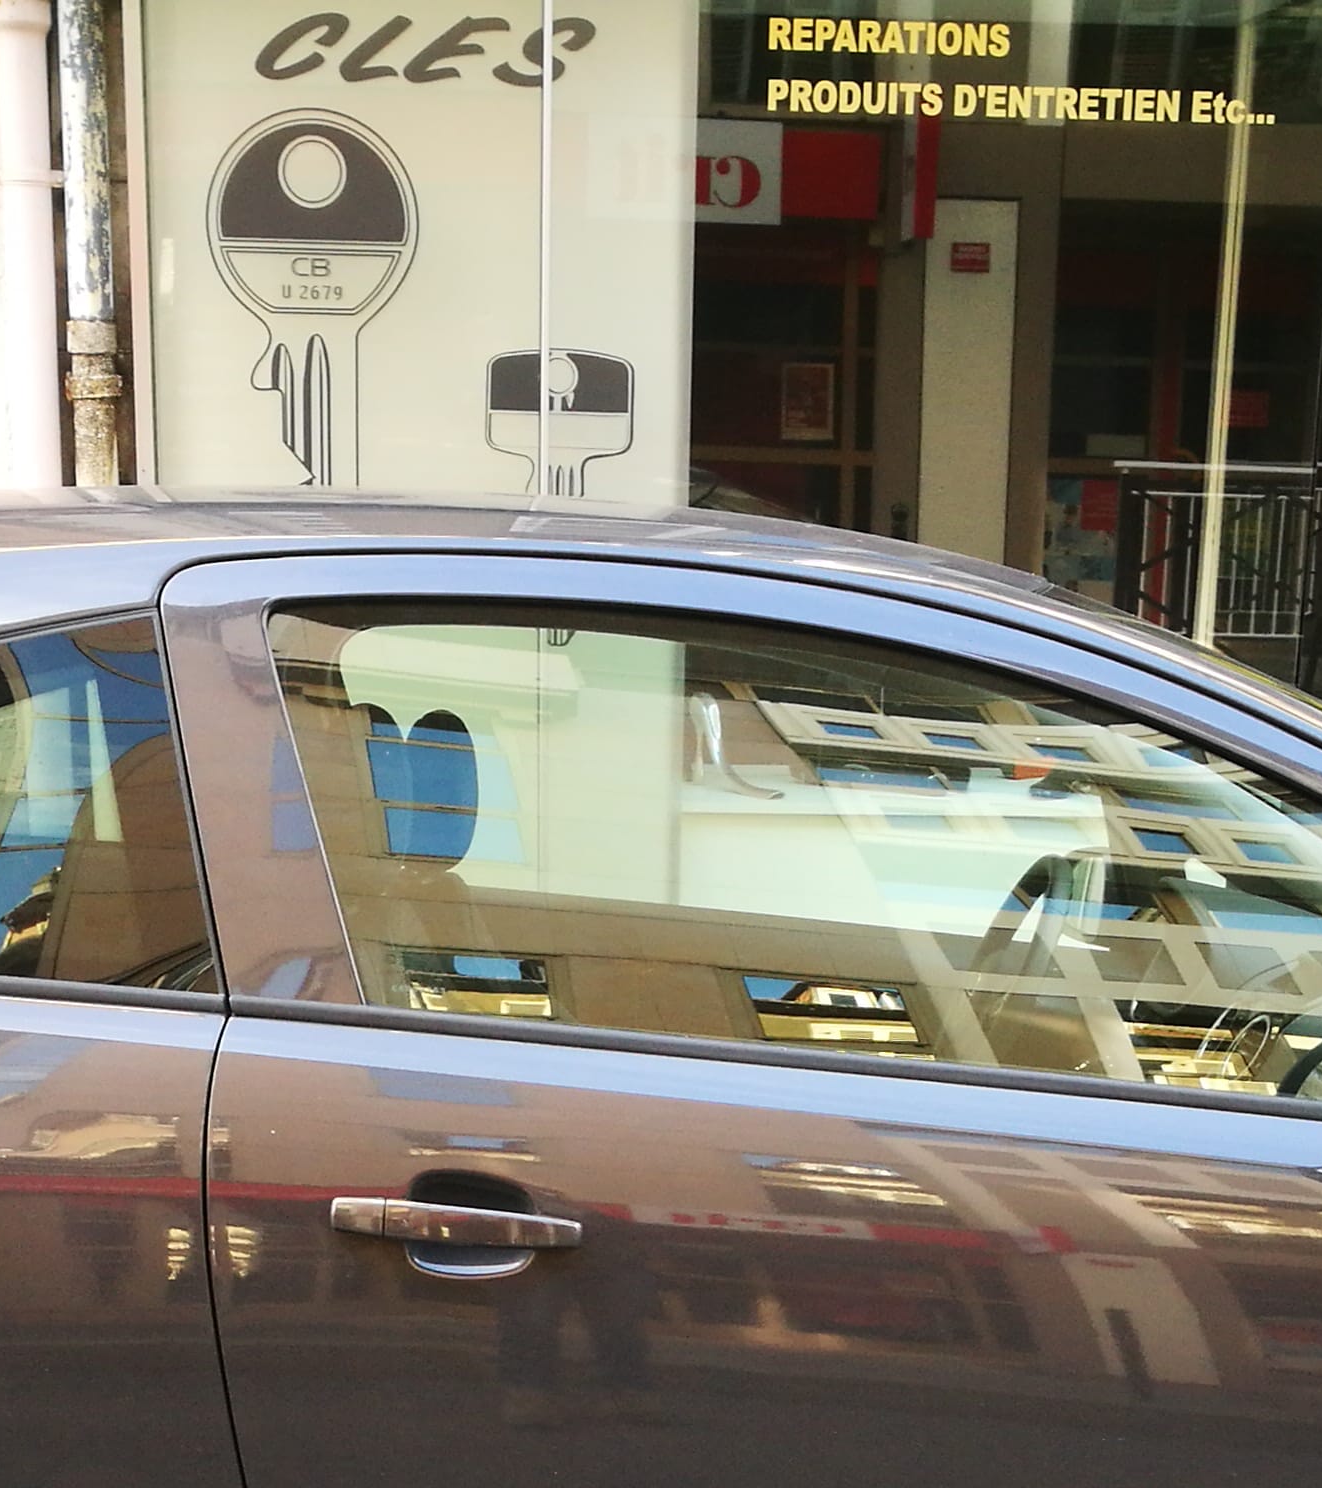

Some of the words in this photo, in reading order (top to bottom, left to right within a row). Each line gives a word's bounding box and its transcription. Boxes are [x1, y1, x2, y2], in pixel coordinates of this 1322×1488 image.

[254, 11, 598, 89] CLES
[768, 16, 1012, 58] REPARATIONS
[766, 78, 944, 118] PRODUITS
[953, 82, 1180, 123] D'ENTRETIEN
[1190, 89, 1277, 127] Etc...
[291, 256, 332, 277] CB
[281, 284, 292, 299] U
[299, 284, 344, 301] 2679
